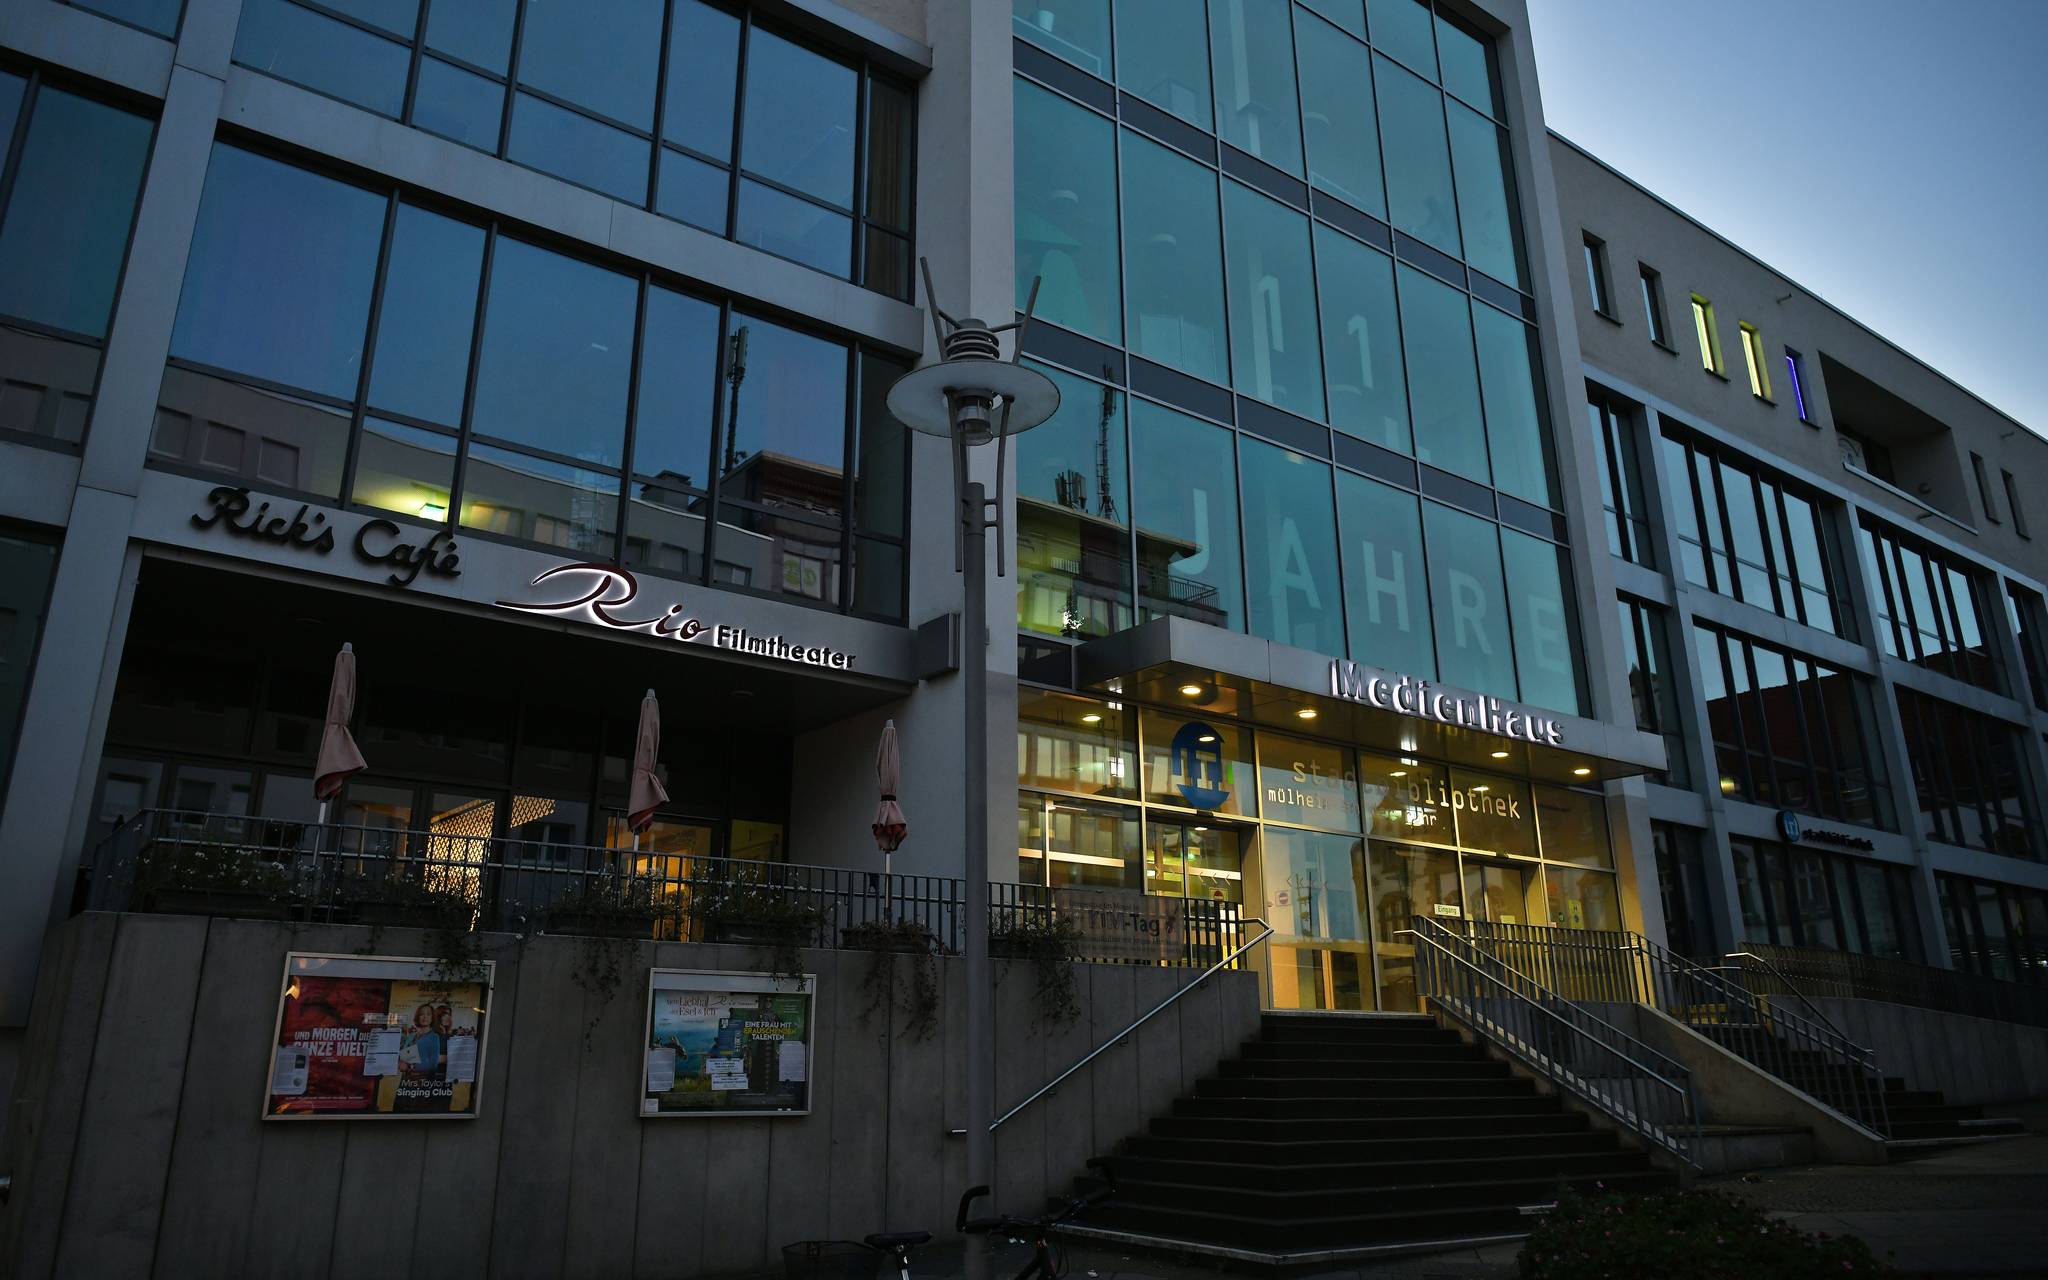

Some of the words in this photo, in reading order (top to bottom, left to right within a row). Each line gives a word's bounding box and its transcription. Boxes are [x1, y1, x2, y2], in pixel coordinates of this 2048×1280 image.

[191, 486, 335, 554] Rick's
[355, 519, 461, 586] Café
[1170, 487, 1571, 676] JAHRE
[494, 562, 711, 640] Rio
[716, 625, 857, 670] Filmtheater
[1437, 905, 1457, 915] Eingang
[294, 1031, 310, 1041] UND
[311, 1027, 358, 1041] MORGEN
[751, 1033, 785, 1041] TALENTEN
[336, 1041, 368, 1057] WELT
[396, 1088, 431, 1098] Singing
[432, 1088, 453, 1097] Club
